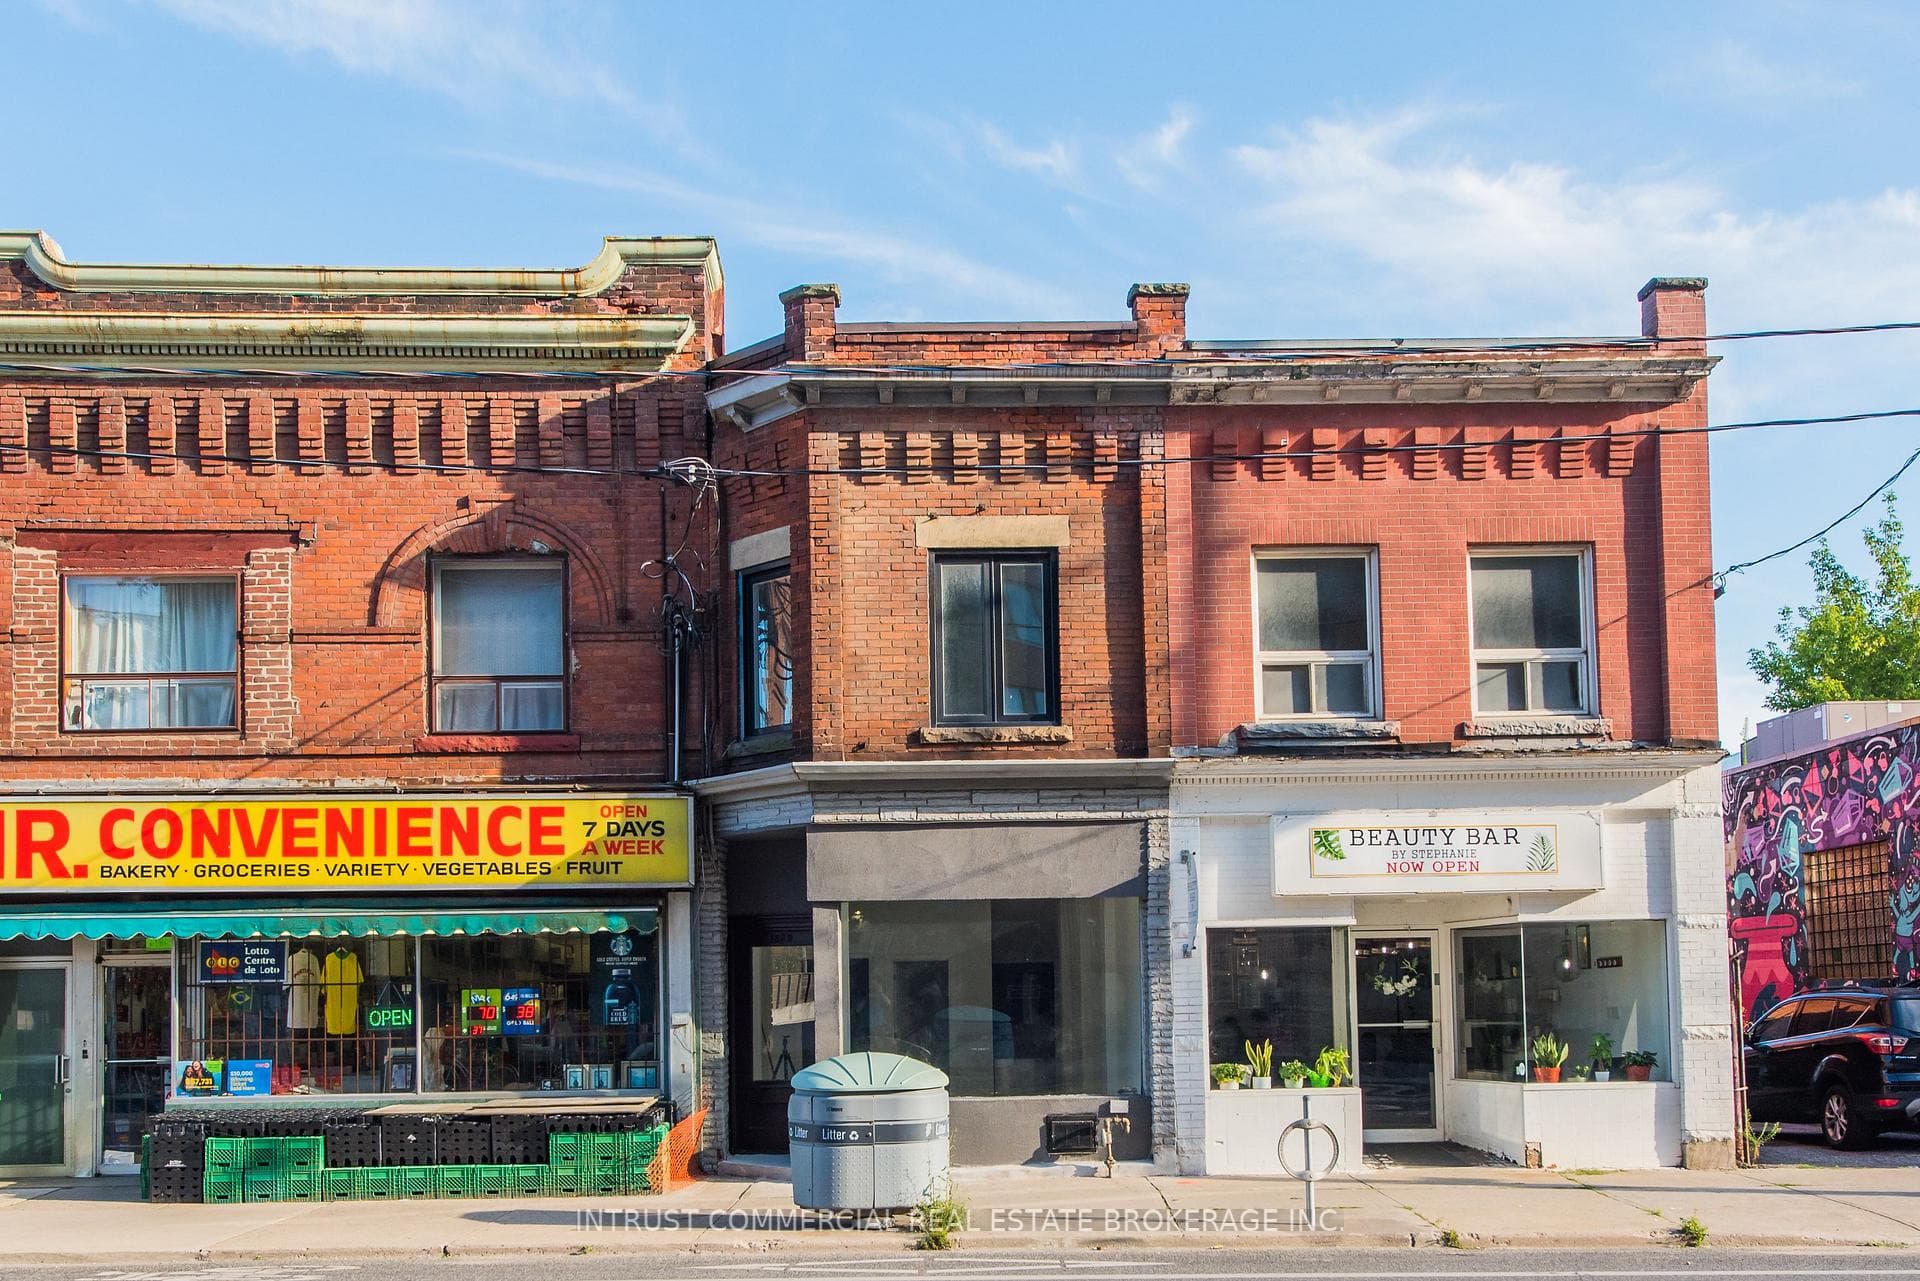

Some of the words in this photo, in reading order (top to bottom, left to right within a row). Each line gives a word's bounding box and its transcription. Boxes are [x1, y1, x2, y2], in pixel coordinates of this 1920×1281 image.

[600, 805, 647, 818] OPEN
[582, 822, 598, 837] 7
[606, 821, 665, 837] DAYS
[0, 809, 88, 879] R.
[99, 807, 565, 859] CONVENIENCE
[1349, 828, 1456, 846] BEAUTY
[1466, 828, 1521, 845] BAR
[581, 840, 599, 855] A
[604, 840, 664, 855] WEEK
[1392, 850, 1407, 859] BY
[1411, 849, 1477, 858] STEPHANIE
[100, 865, 180, 879] BAKERY
[193, 863, 310, 877] GROCERIES
[324, 863, 410, 876] VARIETY
[422, 862, 551, 875] VEGETABLES
[566, 861, 623, 874] FRUIT
[1387, 862, 1424, 873] NOW
[1432, 861, 1480, 872] OPEN
[244, 947, 270, 955] Lotto
[244, 957, 276, 965] Centre
[244, 966, 256, 974] de
[260, 966, 280, 974] Loto
[368, 1009, 412, 1026] OPEN
[479, 1007, 495, 1019] 70
[516, 1006, 534, 1018] 38
[794, 1126, 809, 1139] Litter
[822, 1128, 847, 1141] Litter
